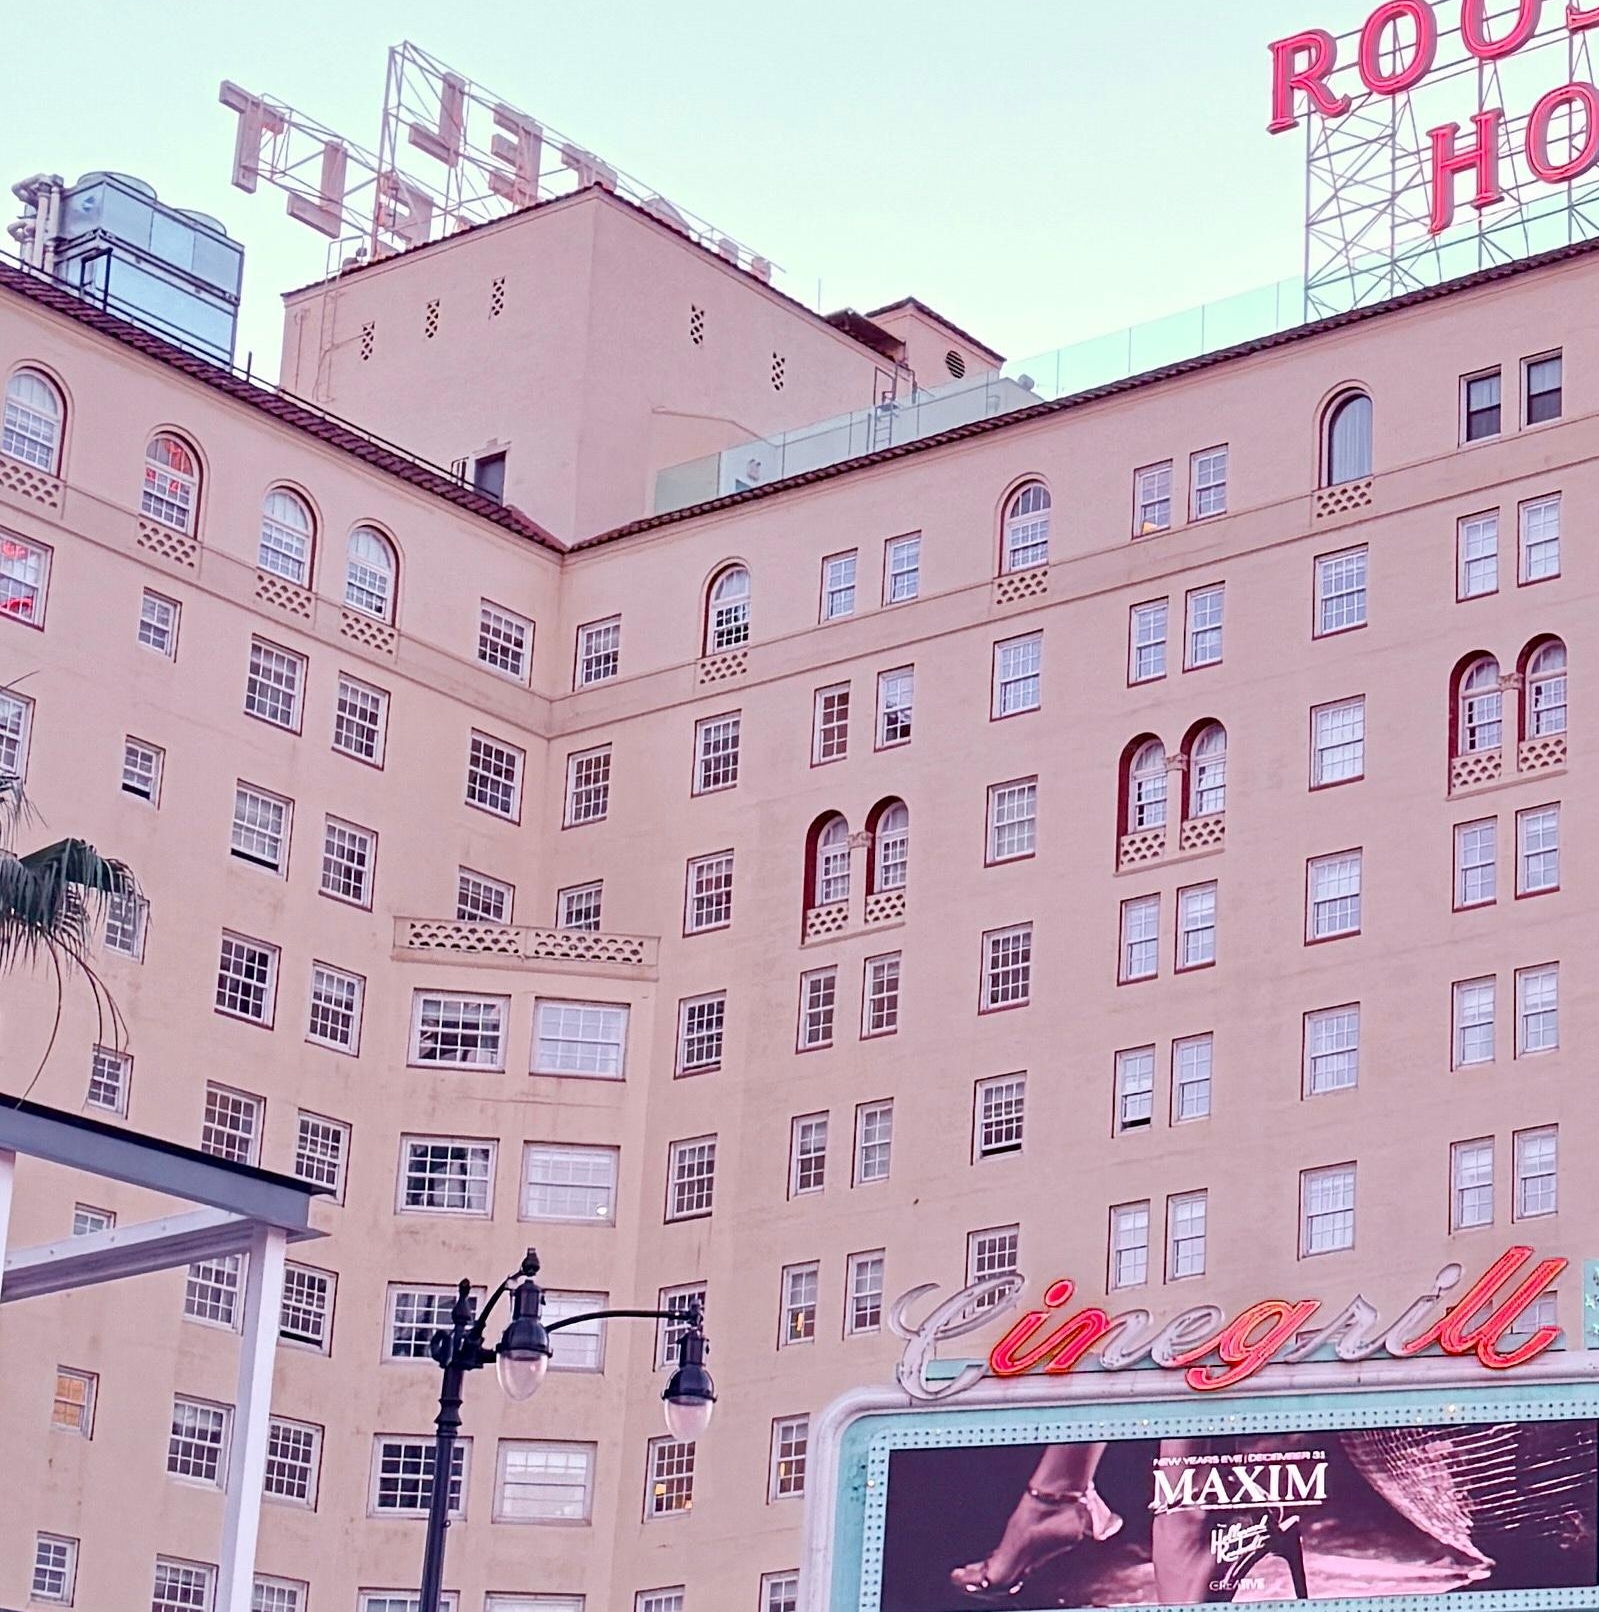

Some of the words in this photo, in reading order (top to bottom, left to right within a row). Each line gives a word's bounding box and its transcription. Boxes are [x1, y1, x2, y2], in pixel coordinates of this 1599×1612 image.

[890, 1245, 1567, 1400] Cinegrill
[1153, 1457, 1182, 1467] NEW
[1184, 1455, 1220, 1465] YEARS
[1221, 1454, 1243, 1464] EVE
[1248, 1451, 1311, 1463] DECEMBER
[1312, 1450, 1326, 1460] 31
[1152, 1463, 1329, 1508] MAXIM
